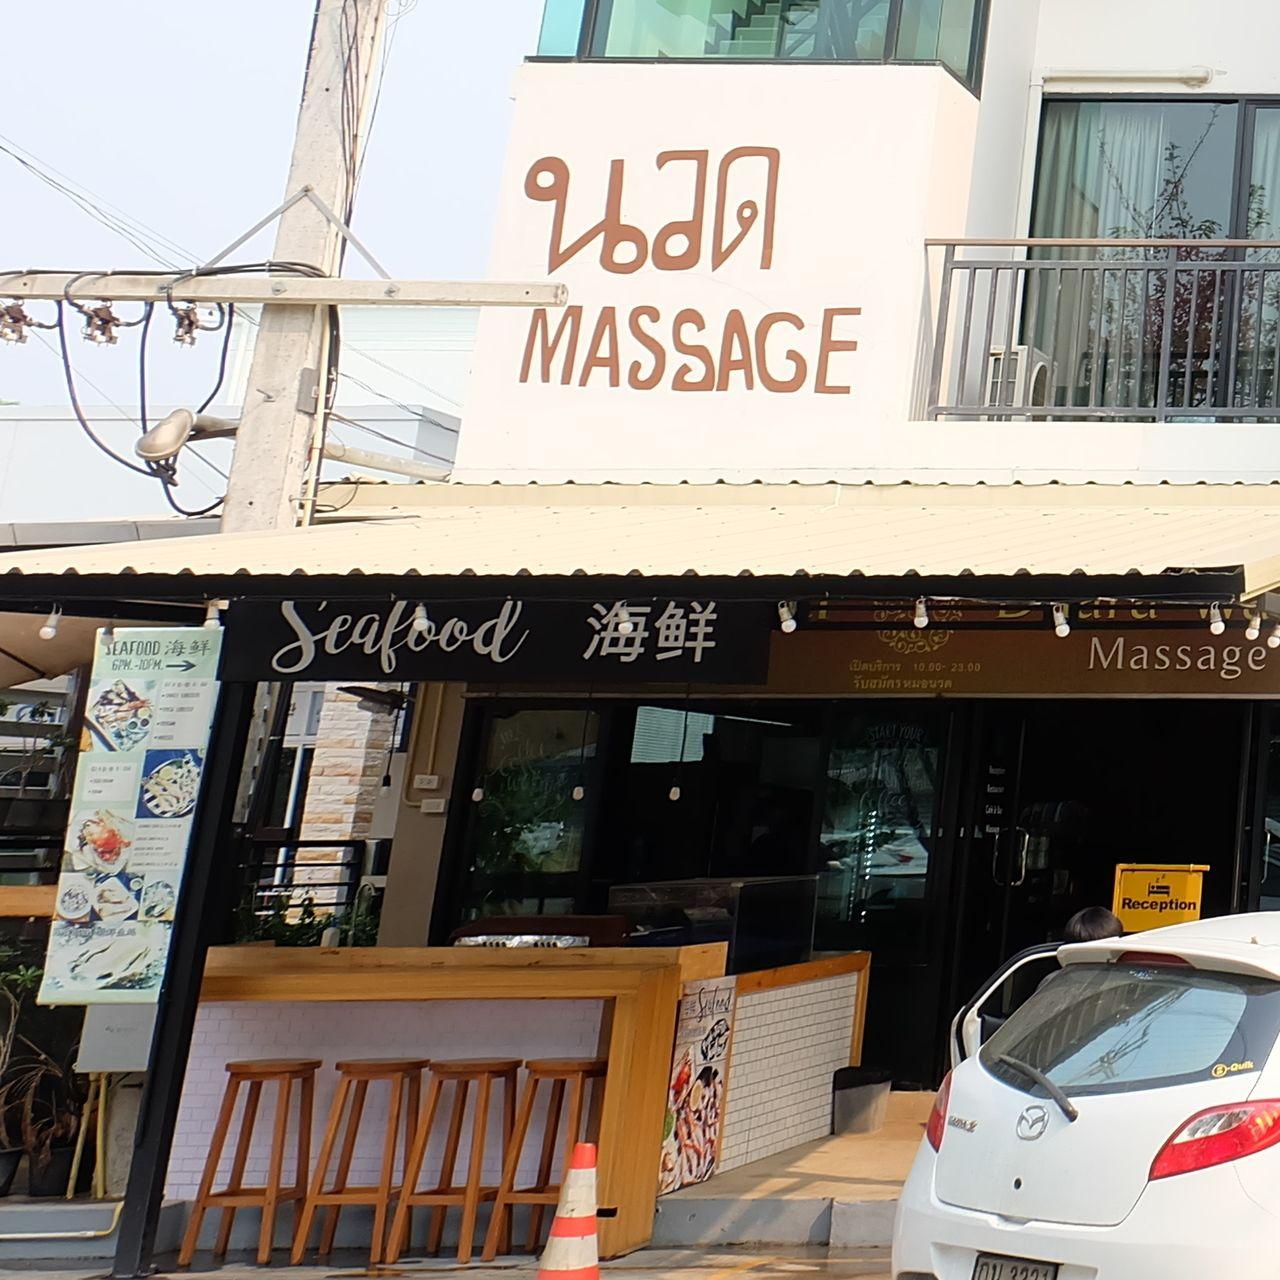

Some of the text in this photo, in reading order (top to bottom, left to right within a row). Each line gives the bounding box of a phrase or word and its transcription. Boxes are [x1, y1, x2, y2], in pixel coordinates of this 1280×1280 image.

[524, 146, 780, 275] นวด
[519, 305, 862, 395] MASSAGE
[271, 600, 530, 674] Seafood
[583, 600, 718, 662] 海鲜
[1088, 636, 1267, 680] Massage
[1122, 897, 1197, 913] Reception
